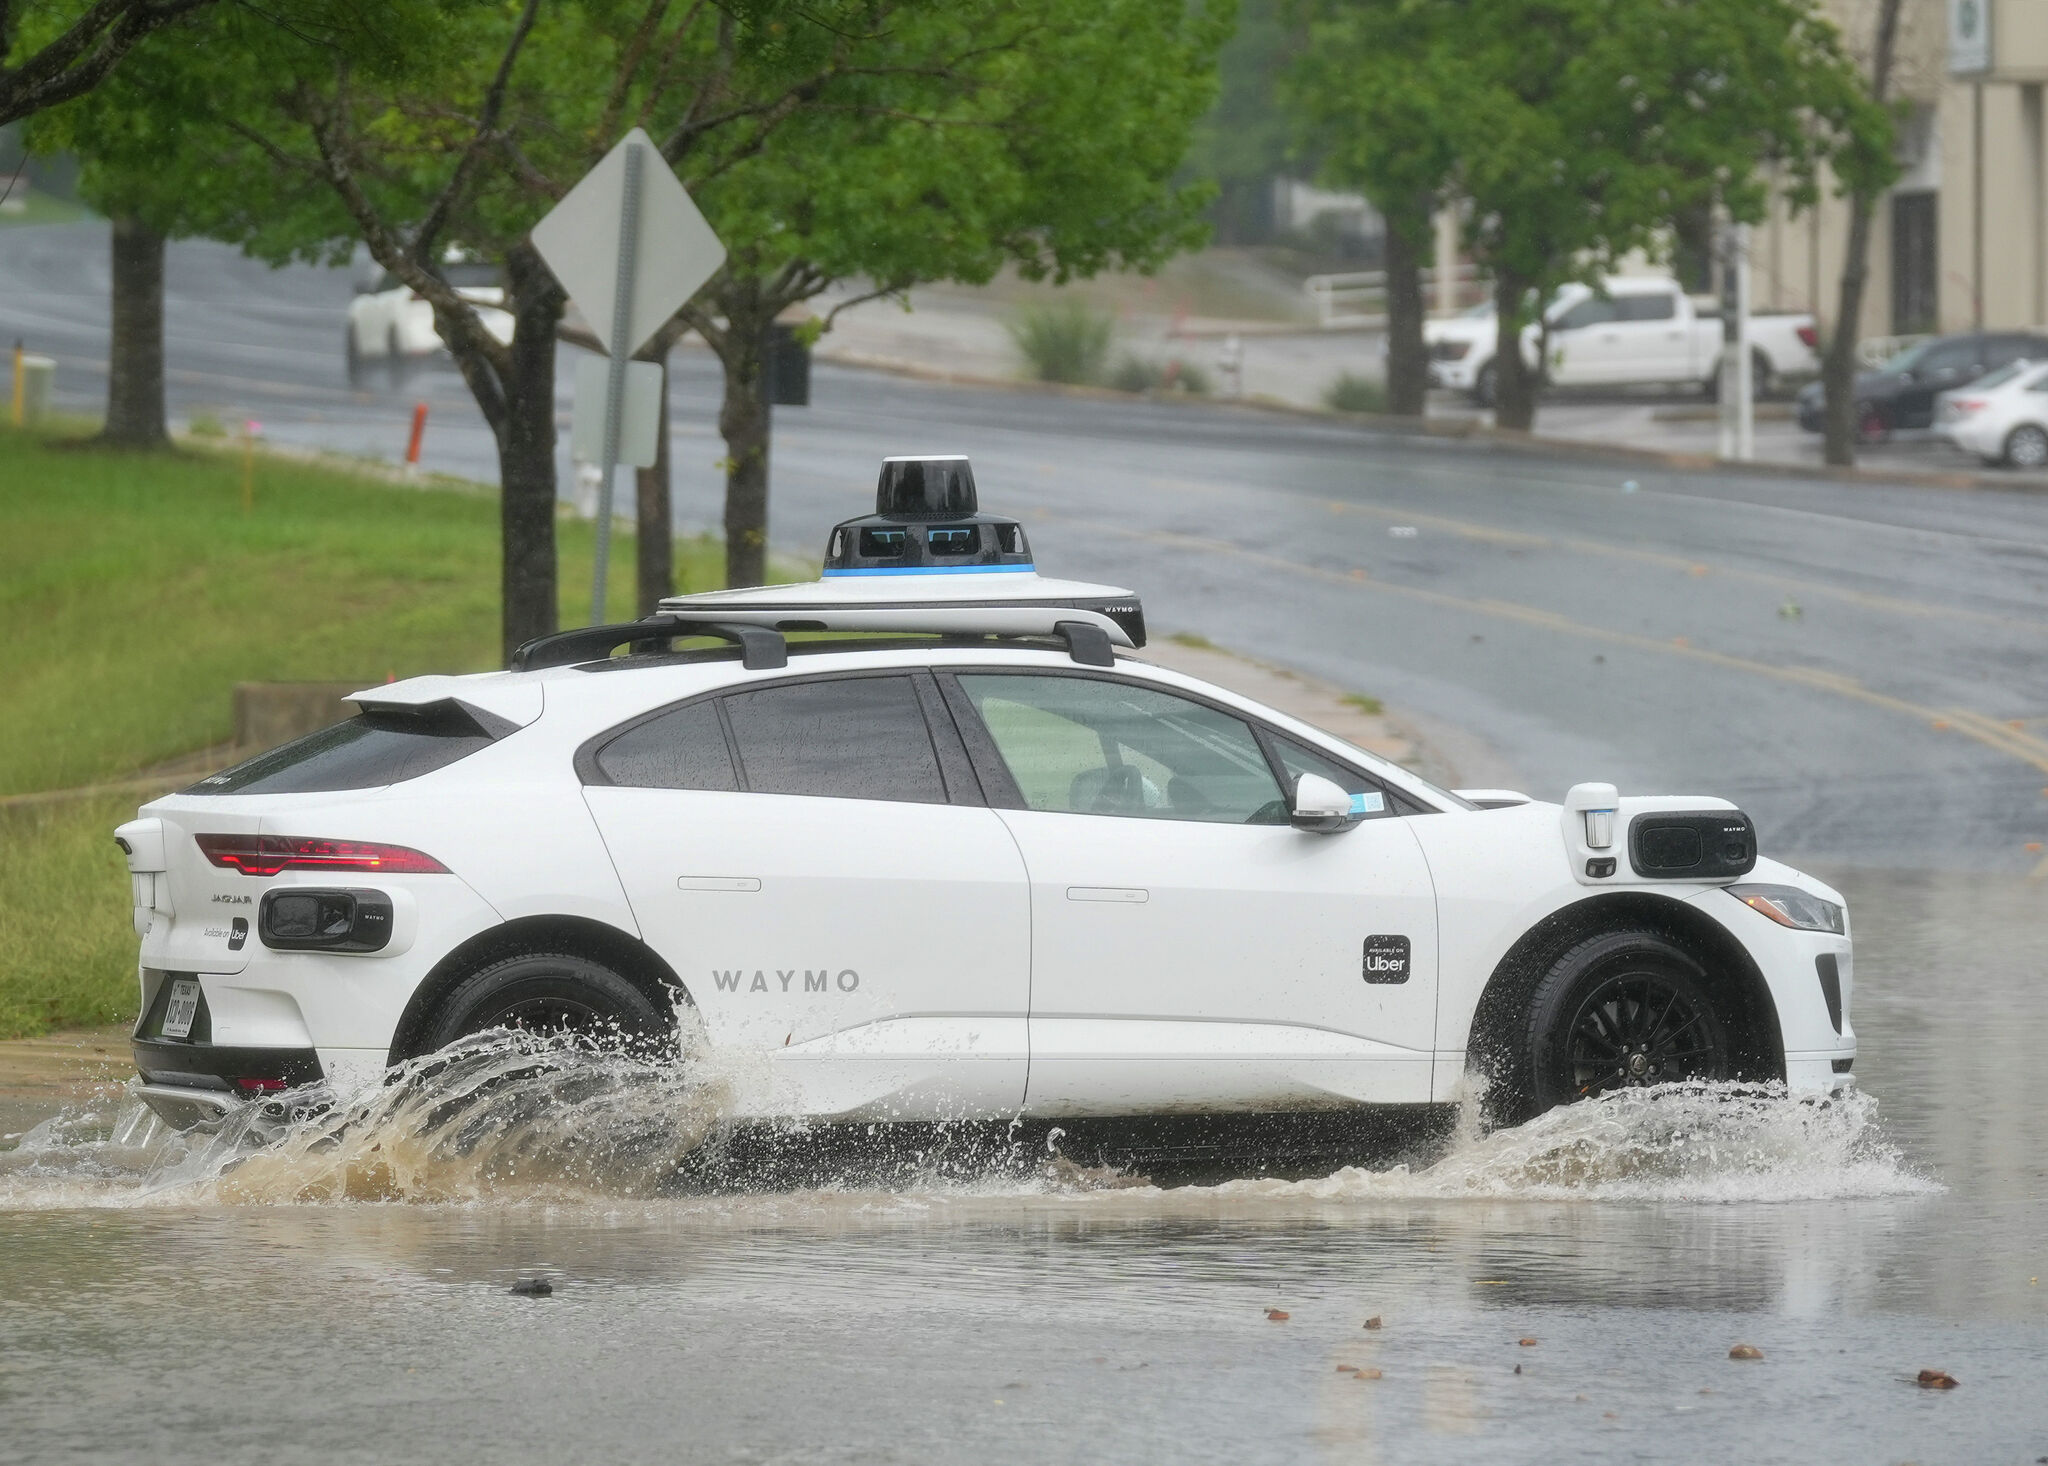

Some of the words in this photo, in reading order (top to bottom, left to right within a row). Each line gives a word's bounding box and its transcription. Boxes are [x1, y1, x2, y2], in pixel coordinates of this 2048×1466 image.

[210, 894, 253, 904] JAGUAR
[231, 928, 247, 940] Uber
[1366, 955, 1406, 971] Uber
[712, 969, 860, 992] WAYMO
